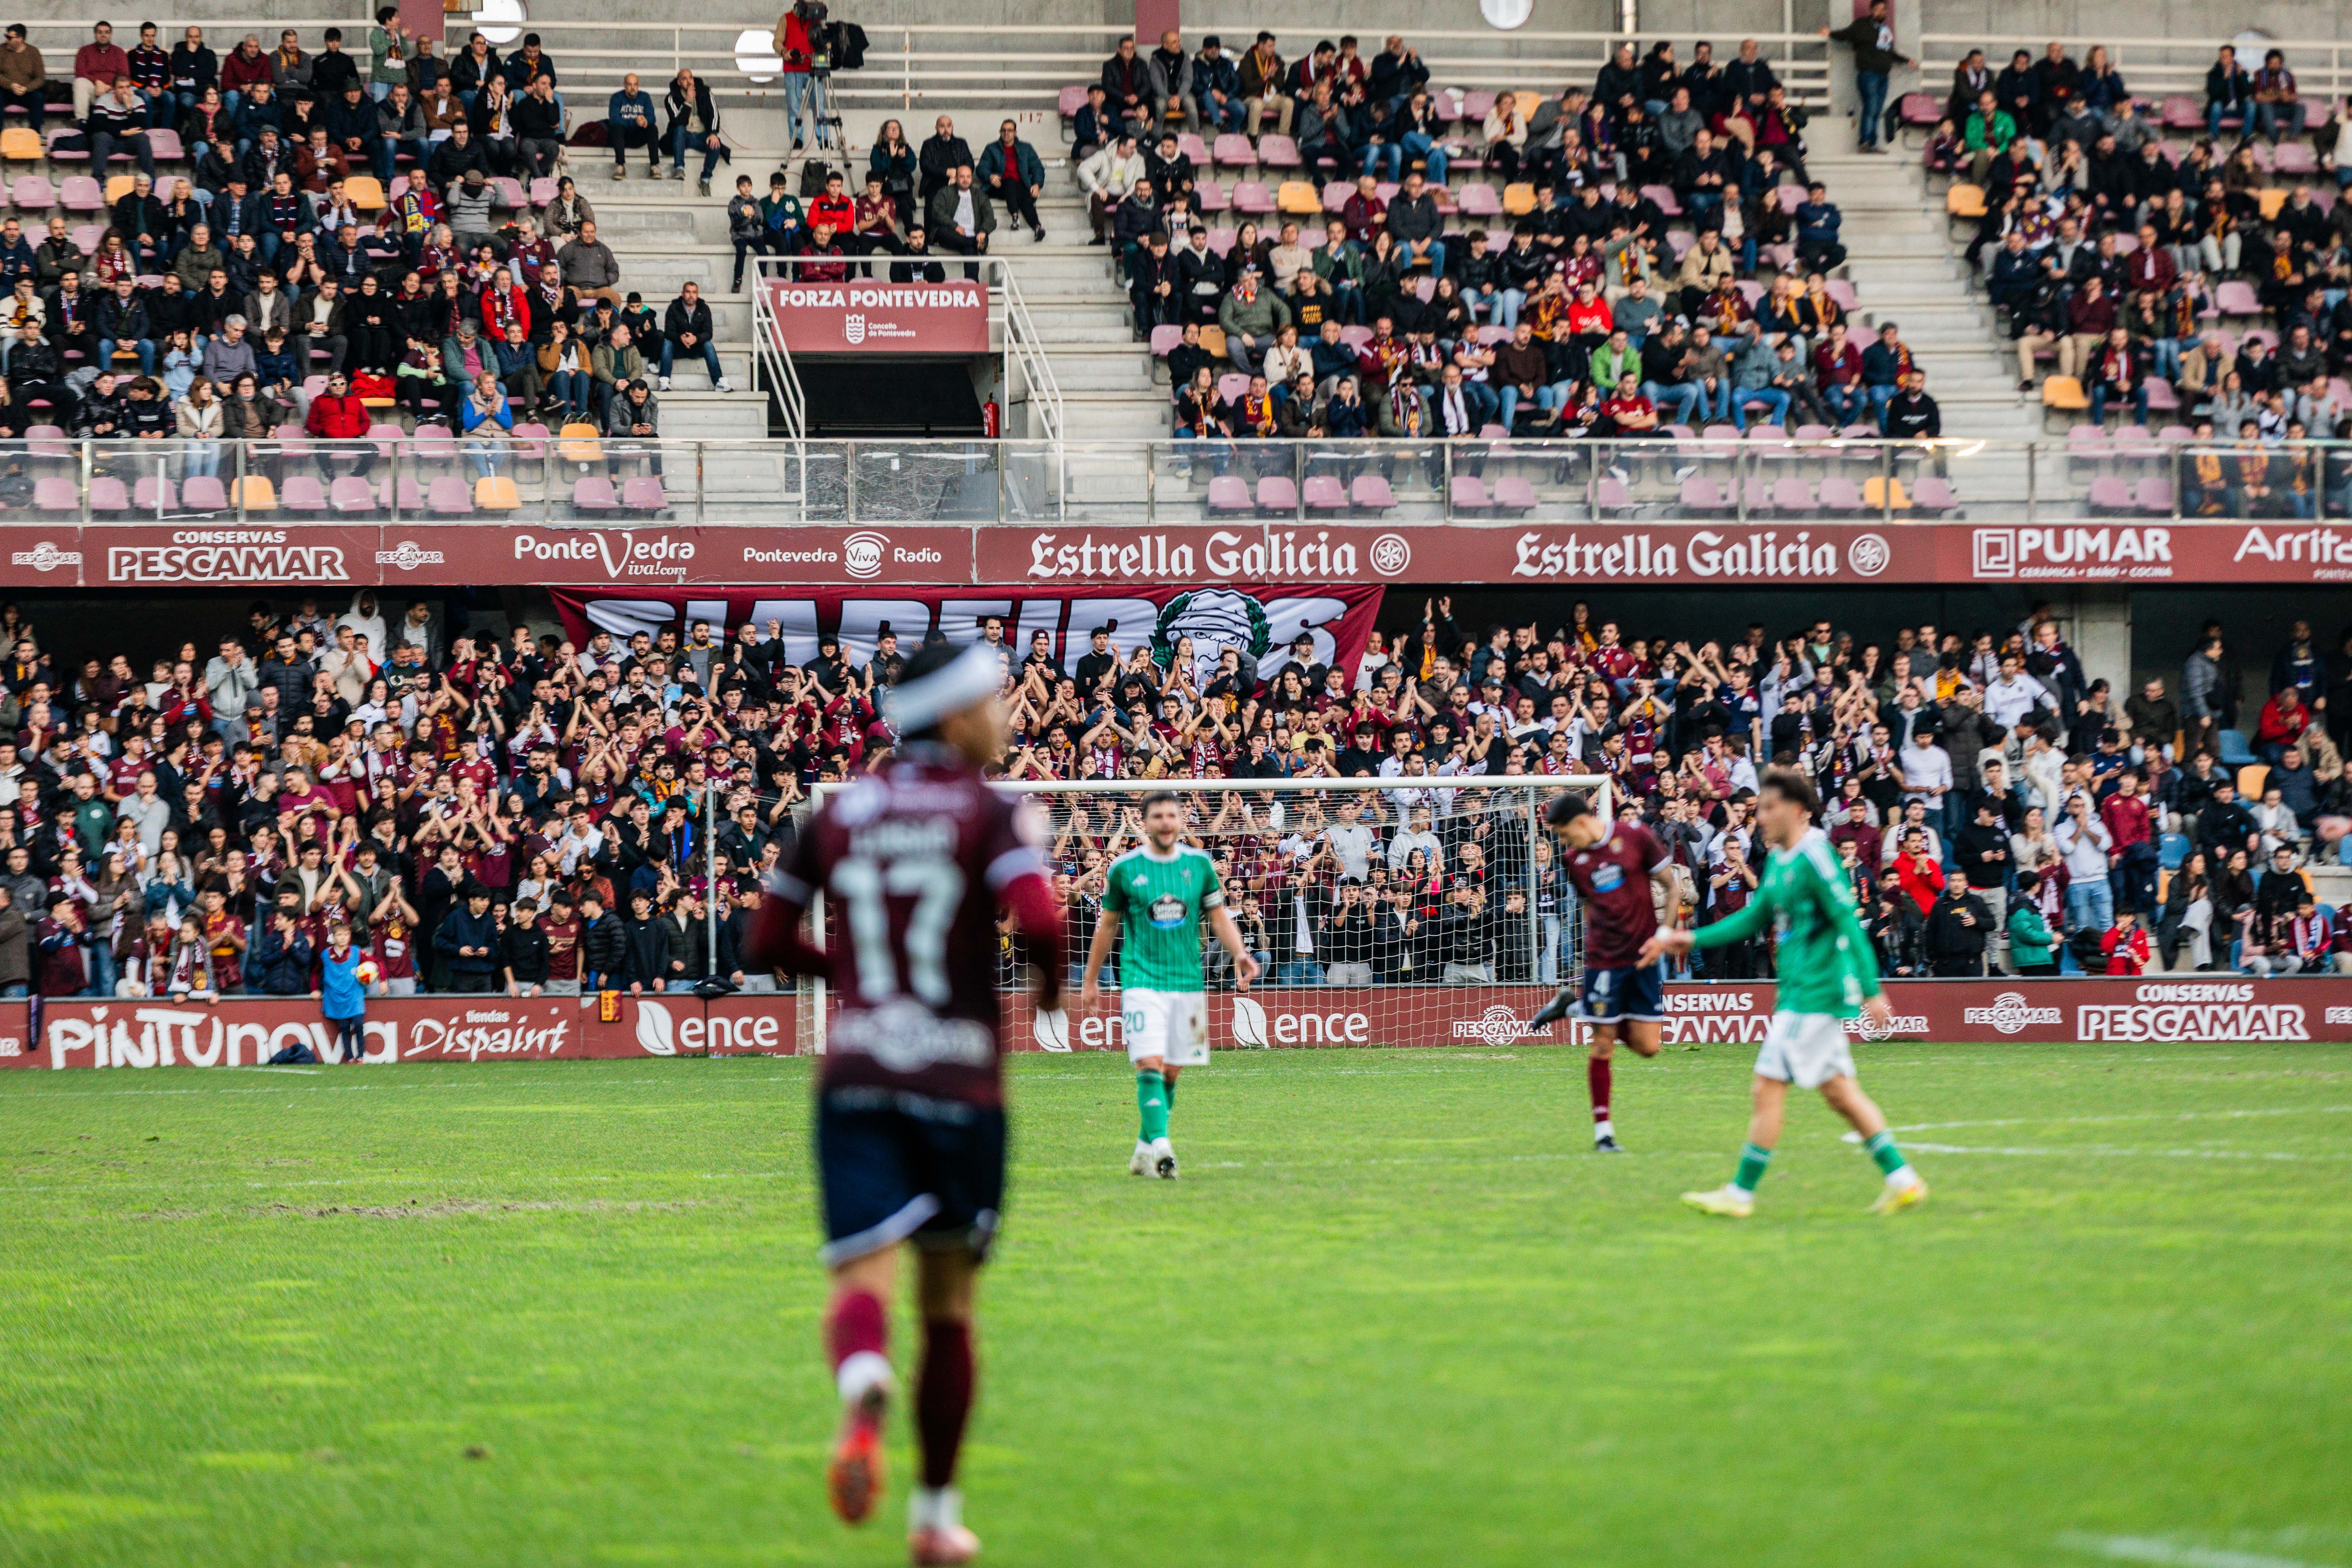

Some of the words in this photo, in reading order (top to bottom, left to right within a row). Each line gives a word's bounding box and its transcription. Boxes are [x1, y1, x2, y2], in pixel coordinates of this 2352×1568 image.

[780, 290, 846, 307] FORZA
[850, 289, 980, 307] PONTEVEDRA
[173, 531, 287, 544] CONSERVAS
[2018, 528, 2172, 562] PUMAR
[12, 552, 82, 566] PESCAMAR
[108, 546, 350, 581] PESCAMAR
[376, 551, 444, 564] PESCAMAR
[743, 548, 837, 563] Pontevedra
[849, 548, 878, 562] Viva
[894, 548, 942, 563] Radio
[1027, 533, 1196, 577] Estrella
[1205, 531, 1358, 577] Galicia
[1512, 532, 1679, 577] Estrella
[1686, 531, 1839, 577] Galicia
[829, 855, 967, 1008] 17
[1594, 970, 1610, 992] 4
[1661, 993, 1753, 1012] NSERVAS
[2136, 984, 2254, 1002] CONSERVAS
[466, 1009, 510, 1023] tiendas
[1483, 1005, 1515, 1014] CONSERVAS
[1964, 1008, 2063, 1024] PESCAMAR
[679, 1016, 779, 1047] ence
[1080, 1016, 1126, 1045] en
[1125, 1011, 1145, 1034] 20
[1274, 1013, 1369, 1043] ence
[2077, 1005, 2311, 1042] PESCAMAR
[404, 1007, 569, 1062] Dispaint
